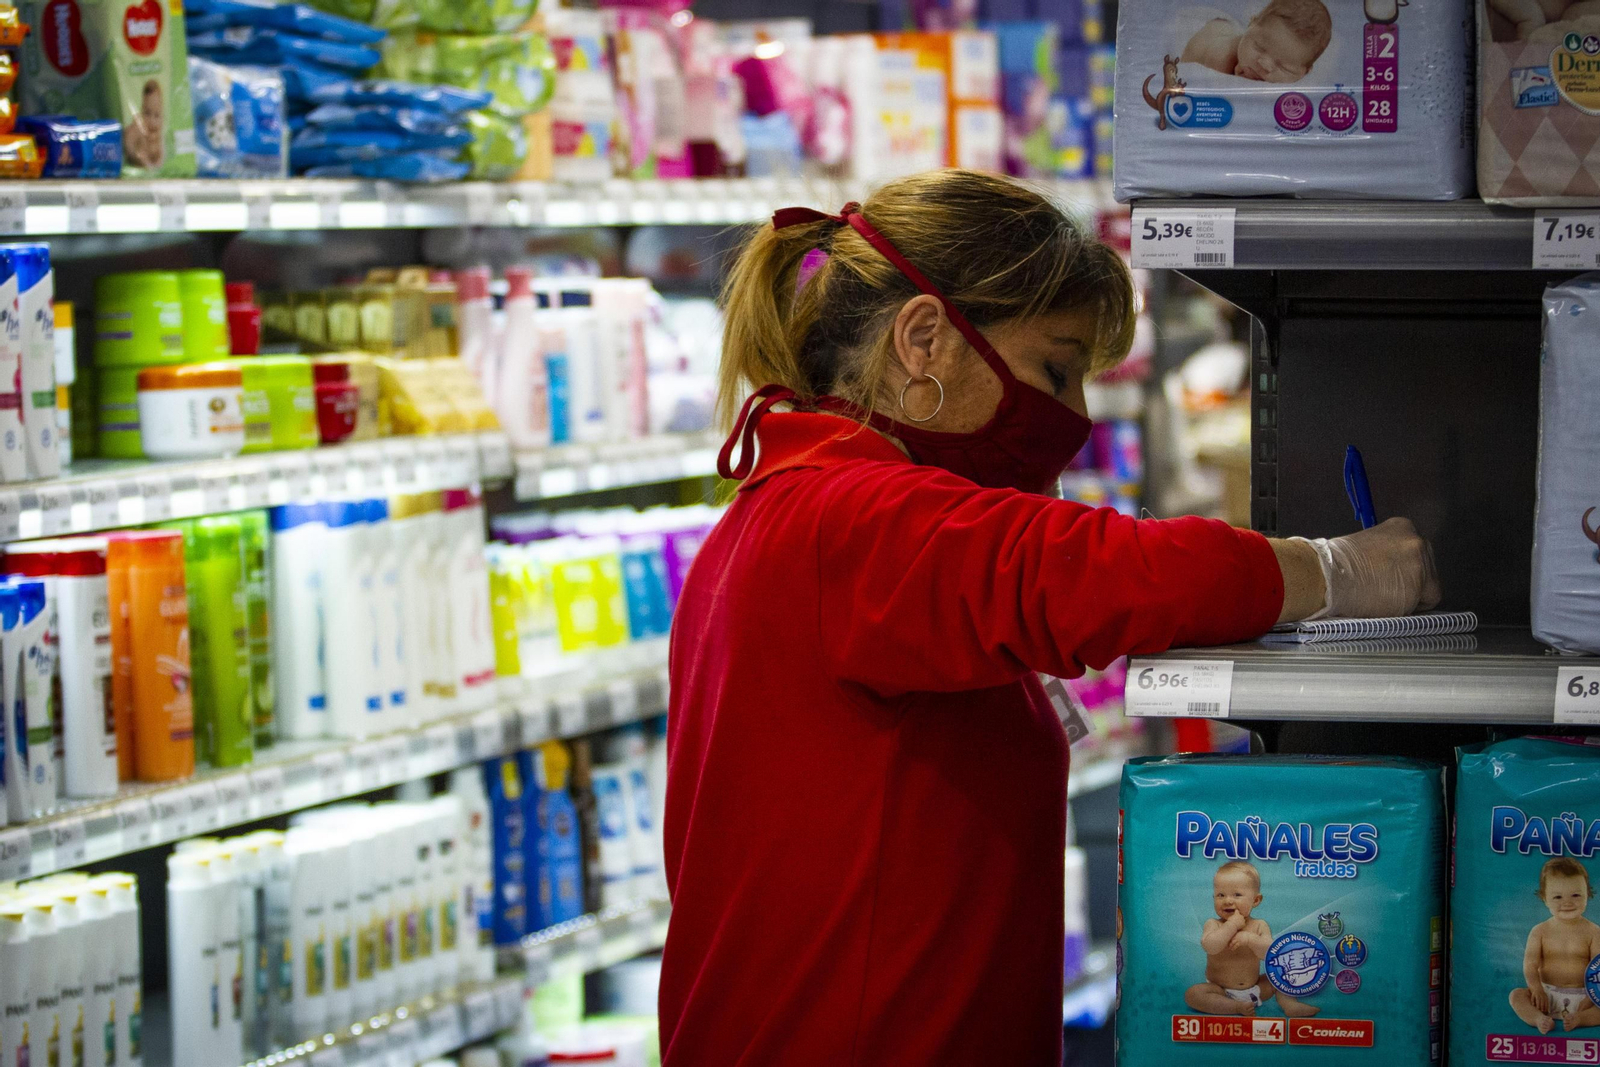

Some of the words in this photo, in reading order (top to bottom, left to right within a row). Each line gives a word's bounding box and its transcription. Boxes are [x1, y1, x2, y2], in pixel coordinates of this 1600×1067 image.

[1378, 32, 1395, 59] 2
[1366, 66, 1394, 82] 3-6
[1519, 91, 1556, 104] Elastic!
[1326, 107, 1350, 118] 12H
[1368, 100, 1391, 116] 28
[1142, 217, 1193, 241] 5,39€
[1543, 217, 1595, 242] 7,19€
[1137, 667, 1189, 691] 6,96€
[1176, 810, 1378, 863] PAÑALES
[1294, 860, 1357, 878] fraldas
[1270, 937, 1290, 955] Nuevo
[1291, 933, 1316, 946] Núcleo
[1343, 934, 1354, 942] 12
[1280, 984, 1301, 994] Núcleo
[1300, 972, 1327, 994] Inteligente
[1177, 1018, 1200, 1036] 30
[1207, 1022, 1243, 1037] 10/15
[1268, 1022, 1281, 1040] 4
[1491, 1037, 1514, 1055] 25
[1521, 1042, 1557, 1056] 13/18
[1583, 1042, 1596, 1060] 5
